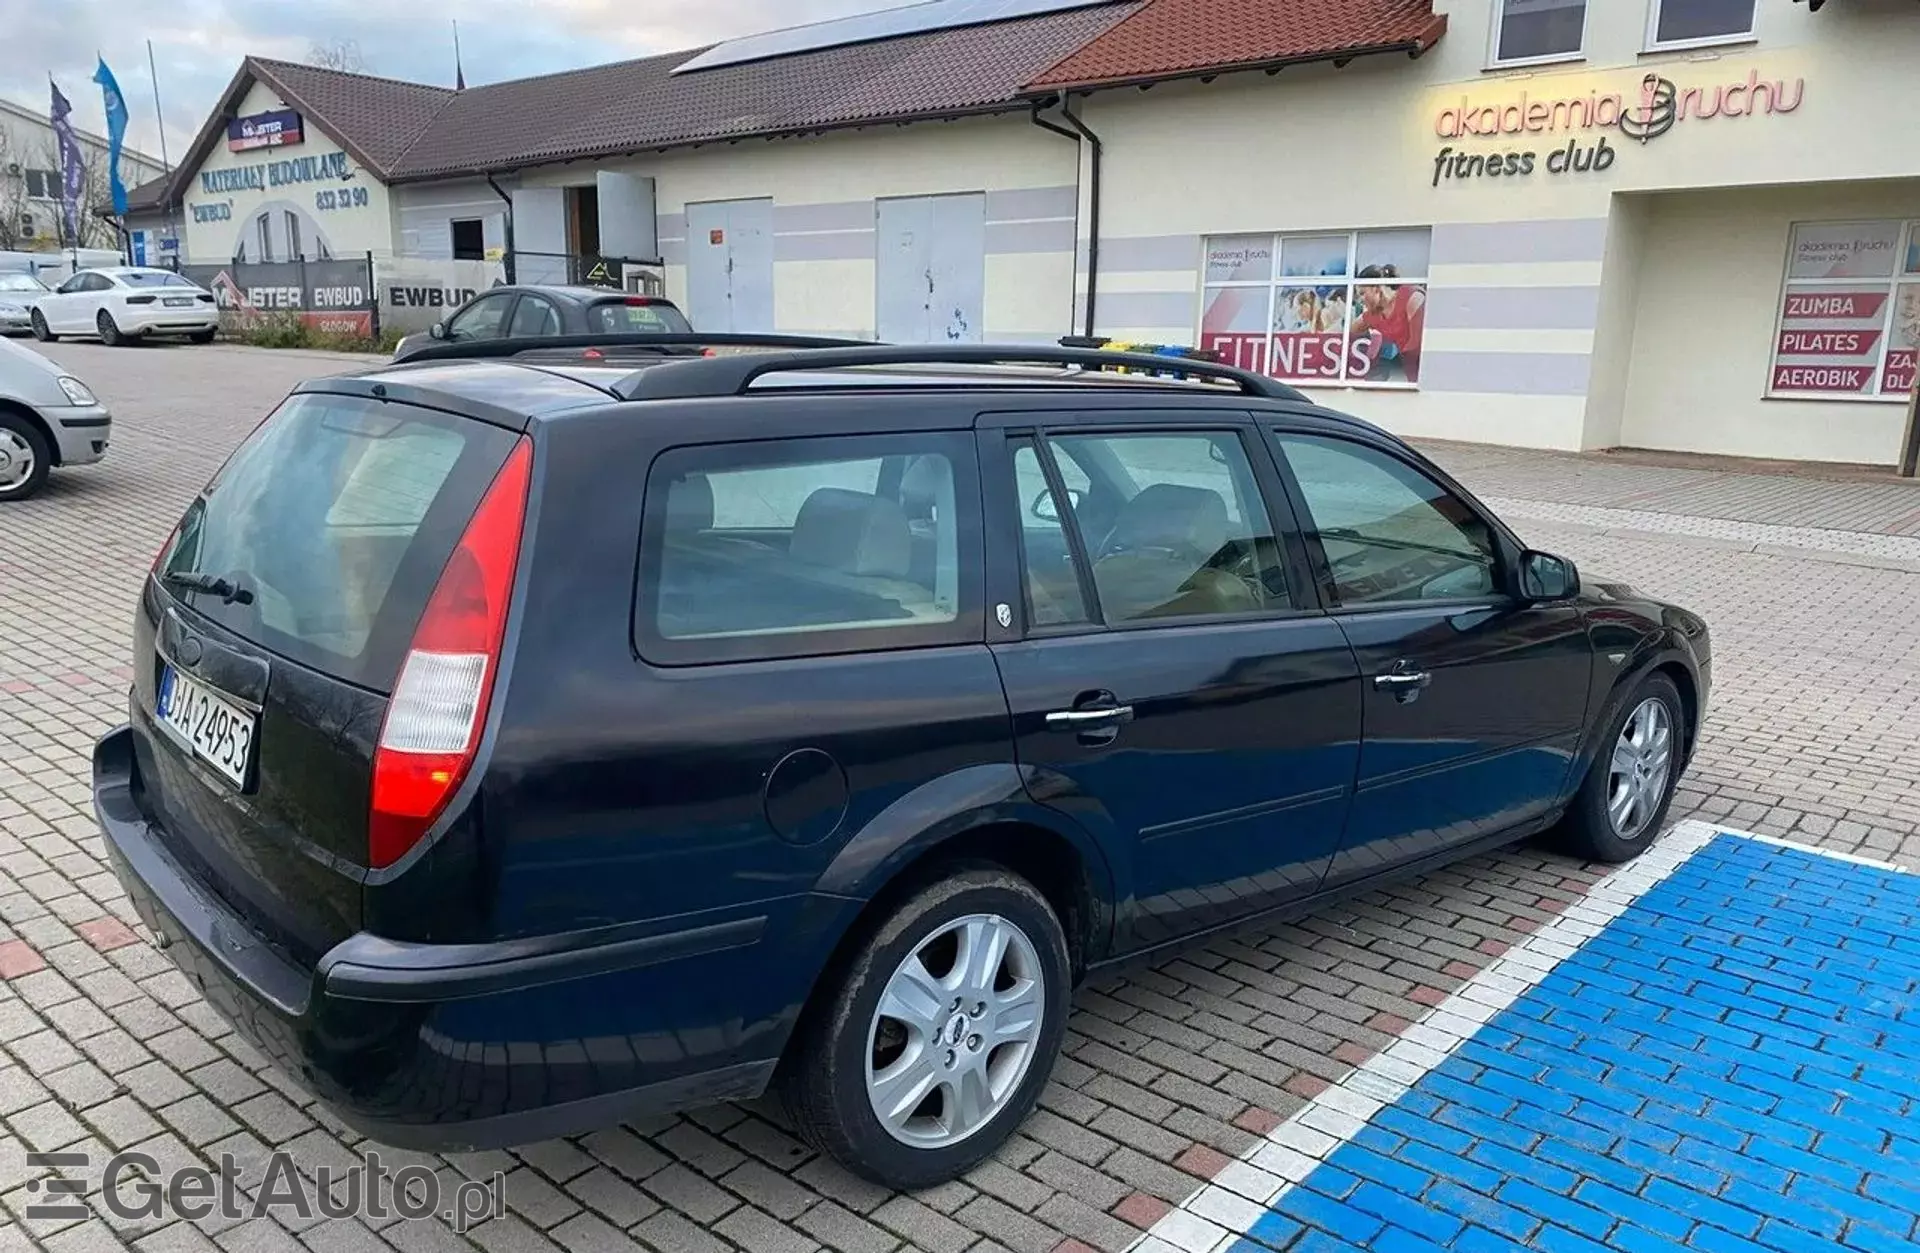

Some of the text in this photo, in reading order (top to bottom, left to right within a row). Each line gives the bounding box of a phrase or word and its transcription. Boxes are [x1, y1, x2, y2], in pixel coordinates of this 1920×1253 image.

[1434, 67, 1804, 138] akademia ruchu
[268, 152, 347, 186] BUDOWLANE
[1432, 137, 1615, 186] fitness club
[316, 186, 368, 210] 832 32 90
[314, 286, 362, 306] EWBUD
[1787, 297, 1855, 315] ZUMBA
[1213, 337, 1372, 376] FITNESS
[1782, 334, 1859, 351] PILATES
[1777, 369, 1860, 387] AEROBIK
[193, 696, 250, 773] 24953
